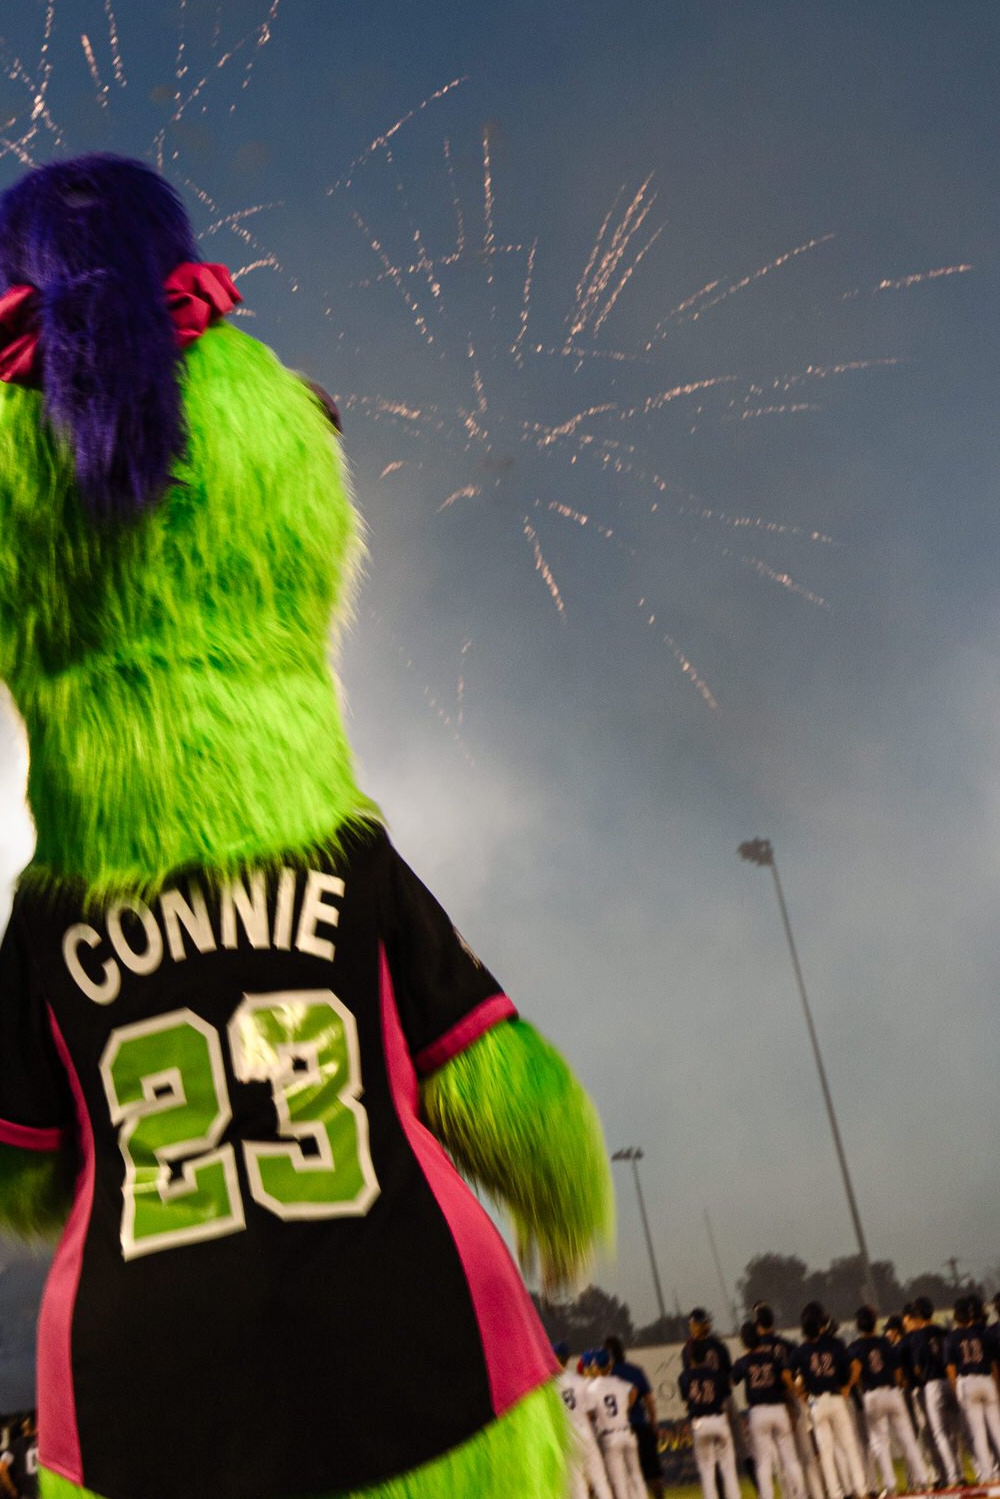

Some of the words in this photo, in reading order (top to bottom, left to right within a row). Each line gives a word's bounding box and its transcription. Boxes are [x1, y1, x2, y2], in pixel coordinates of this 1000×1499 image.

[62, 867, 345, 1006] CONNIE
[100, 988, 381, 1262] 23
[604, 1394, 618, 1417] 9
